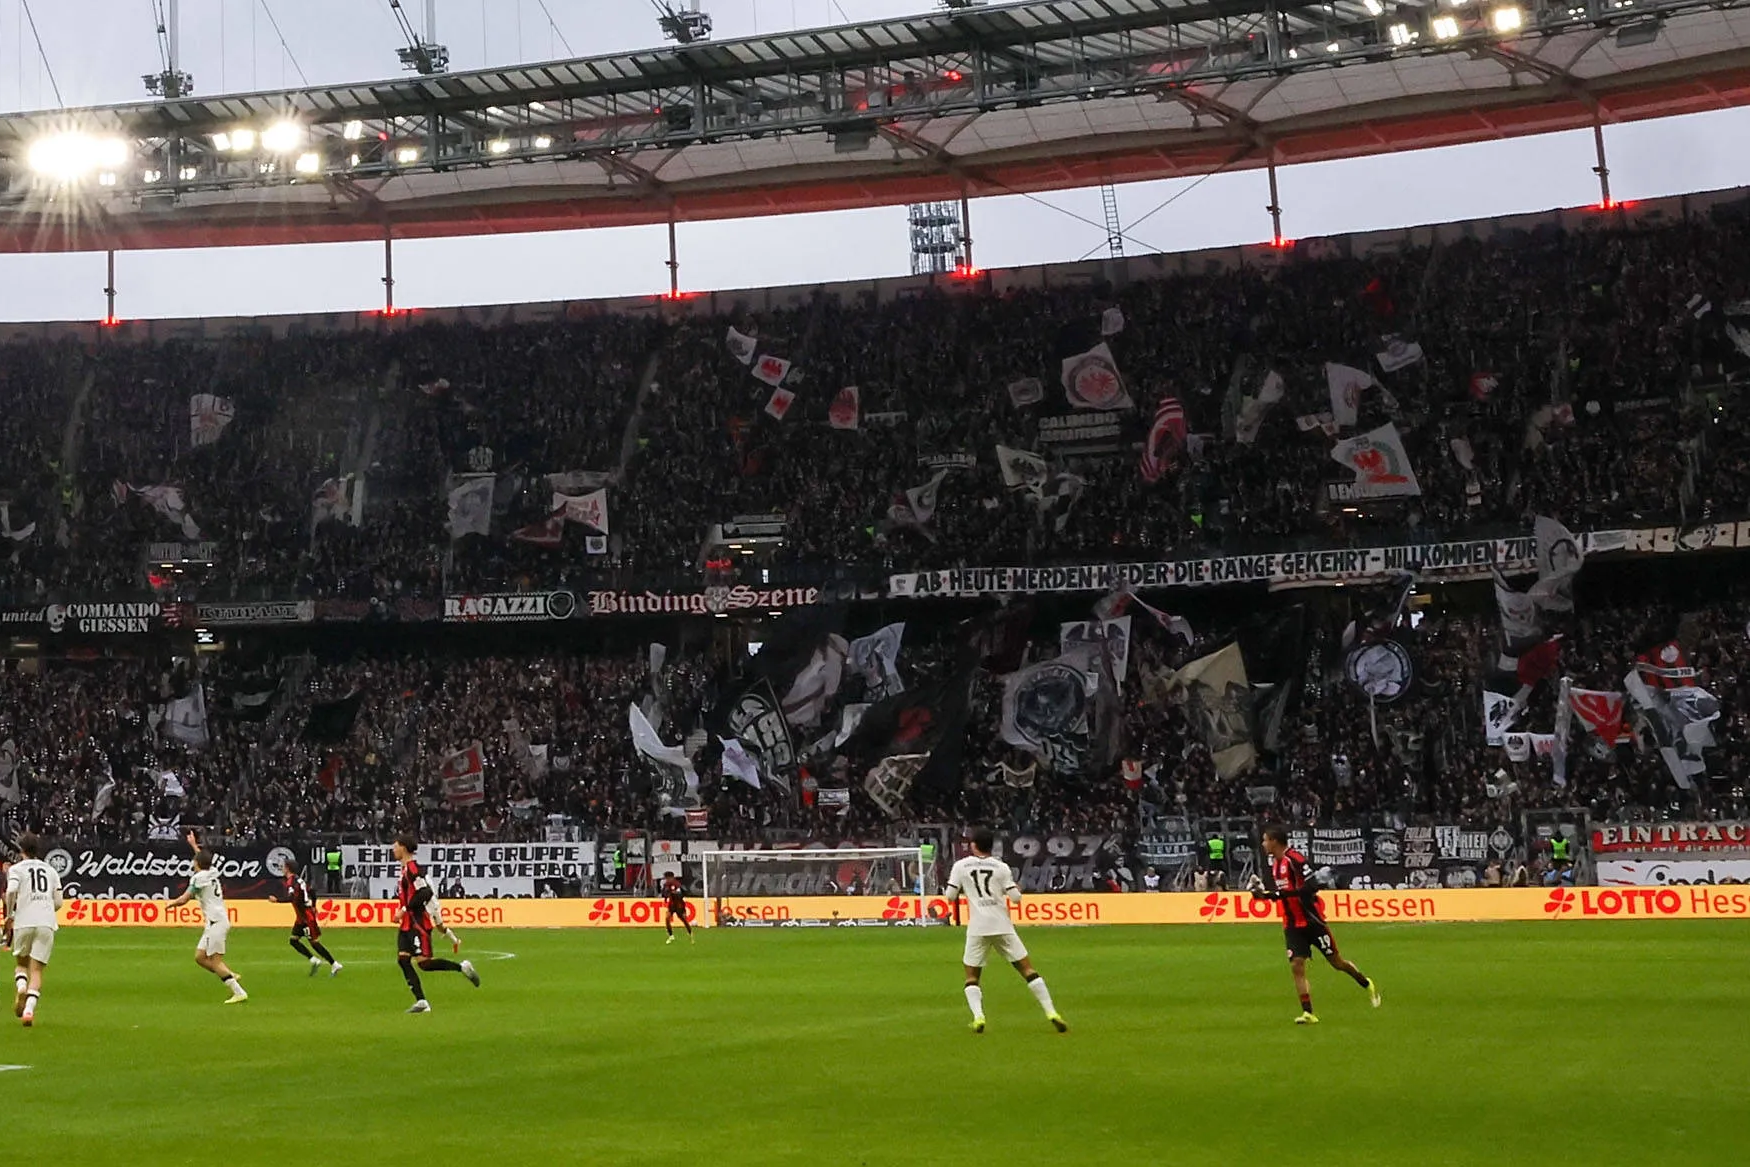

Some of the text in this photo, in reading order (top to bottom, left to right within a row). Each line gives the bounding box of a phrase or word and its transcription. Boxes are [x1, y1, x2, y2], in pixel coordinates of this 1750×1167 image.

[914, 574, 941, 592] AB
[950, 569, 1007, 591] HEUTE
[1098, 563, 1169, 587] WEDER
[1175, 562, 1204, 584] DIE
[1281, 551, 1370, 575] GEKEHRT
[66, 602, 161, 618] COMMANDO
[444, 596, 545, 616] RAGAZZI
[588, 585, 818, 615] Binding Szene
[2, 606, 46, 623] united
[79, 618, 149, 633] GIESSEN
[432, 848, 475, 862] DER
[489, 847, 579, 862] GRUPPE
[28, 868, 47, 893] 16
[970, 869, 993, 898] 17
[1008, 899, 1100, 921] Hessen
[1334, 893, 1435, 917] Hessen
[1581, 888, 1750, 915] LOTTO Hes
[92, 903, 158, 922] LOTTO
[441, 905, 503, 923] essen
[1318, 934, 1331, 948] 19
